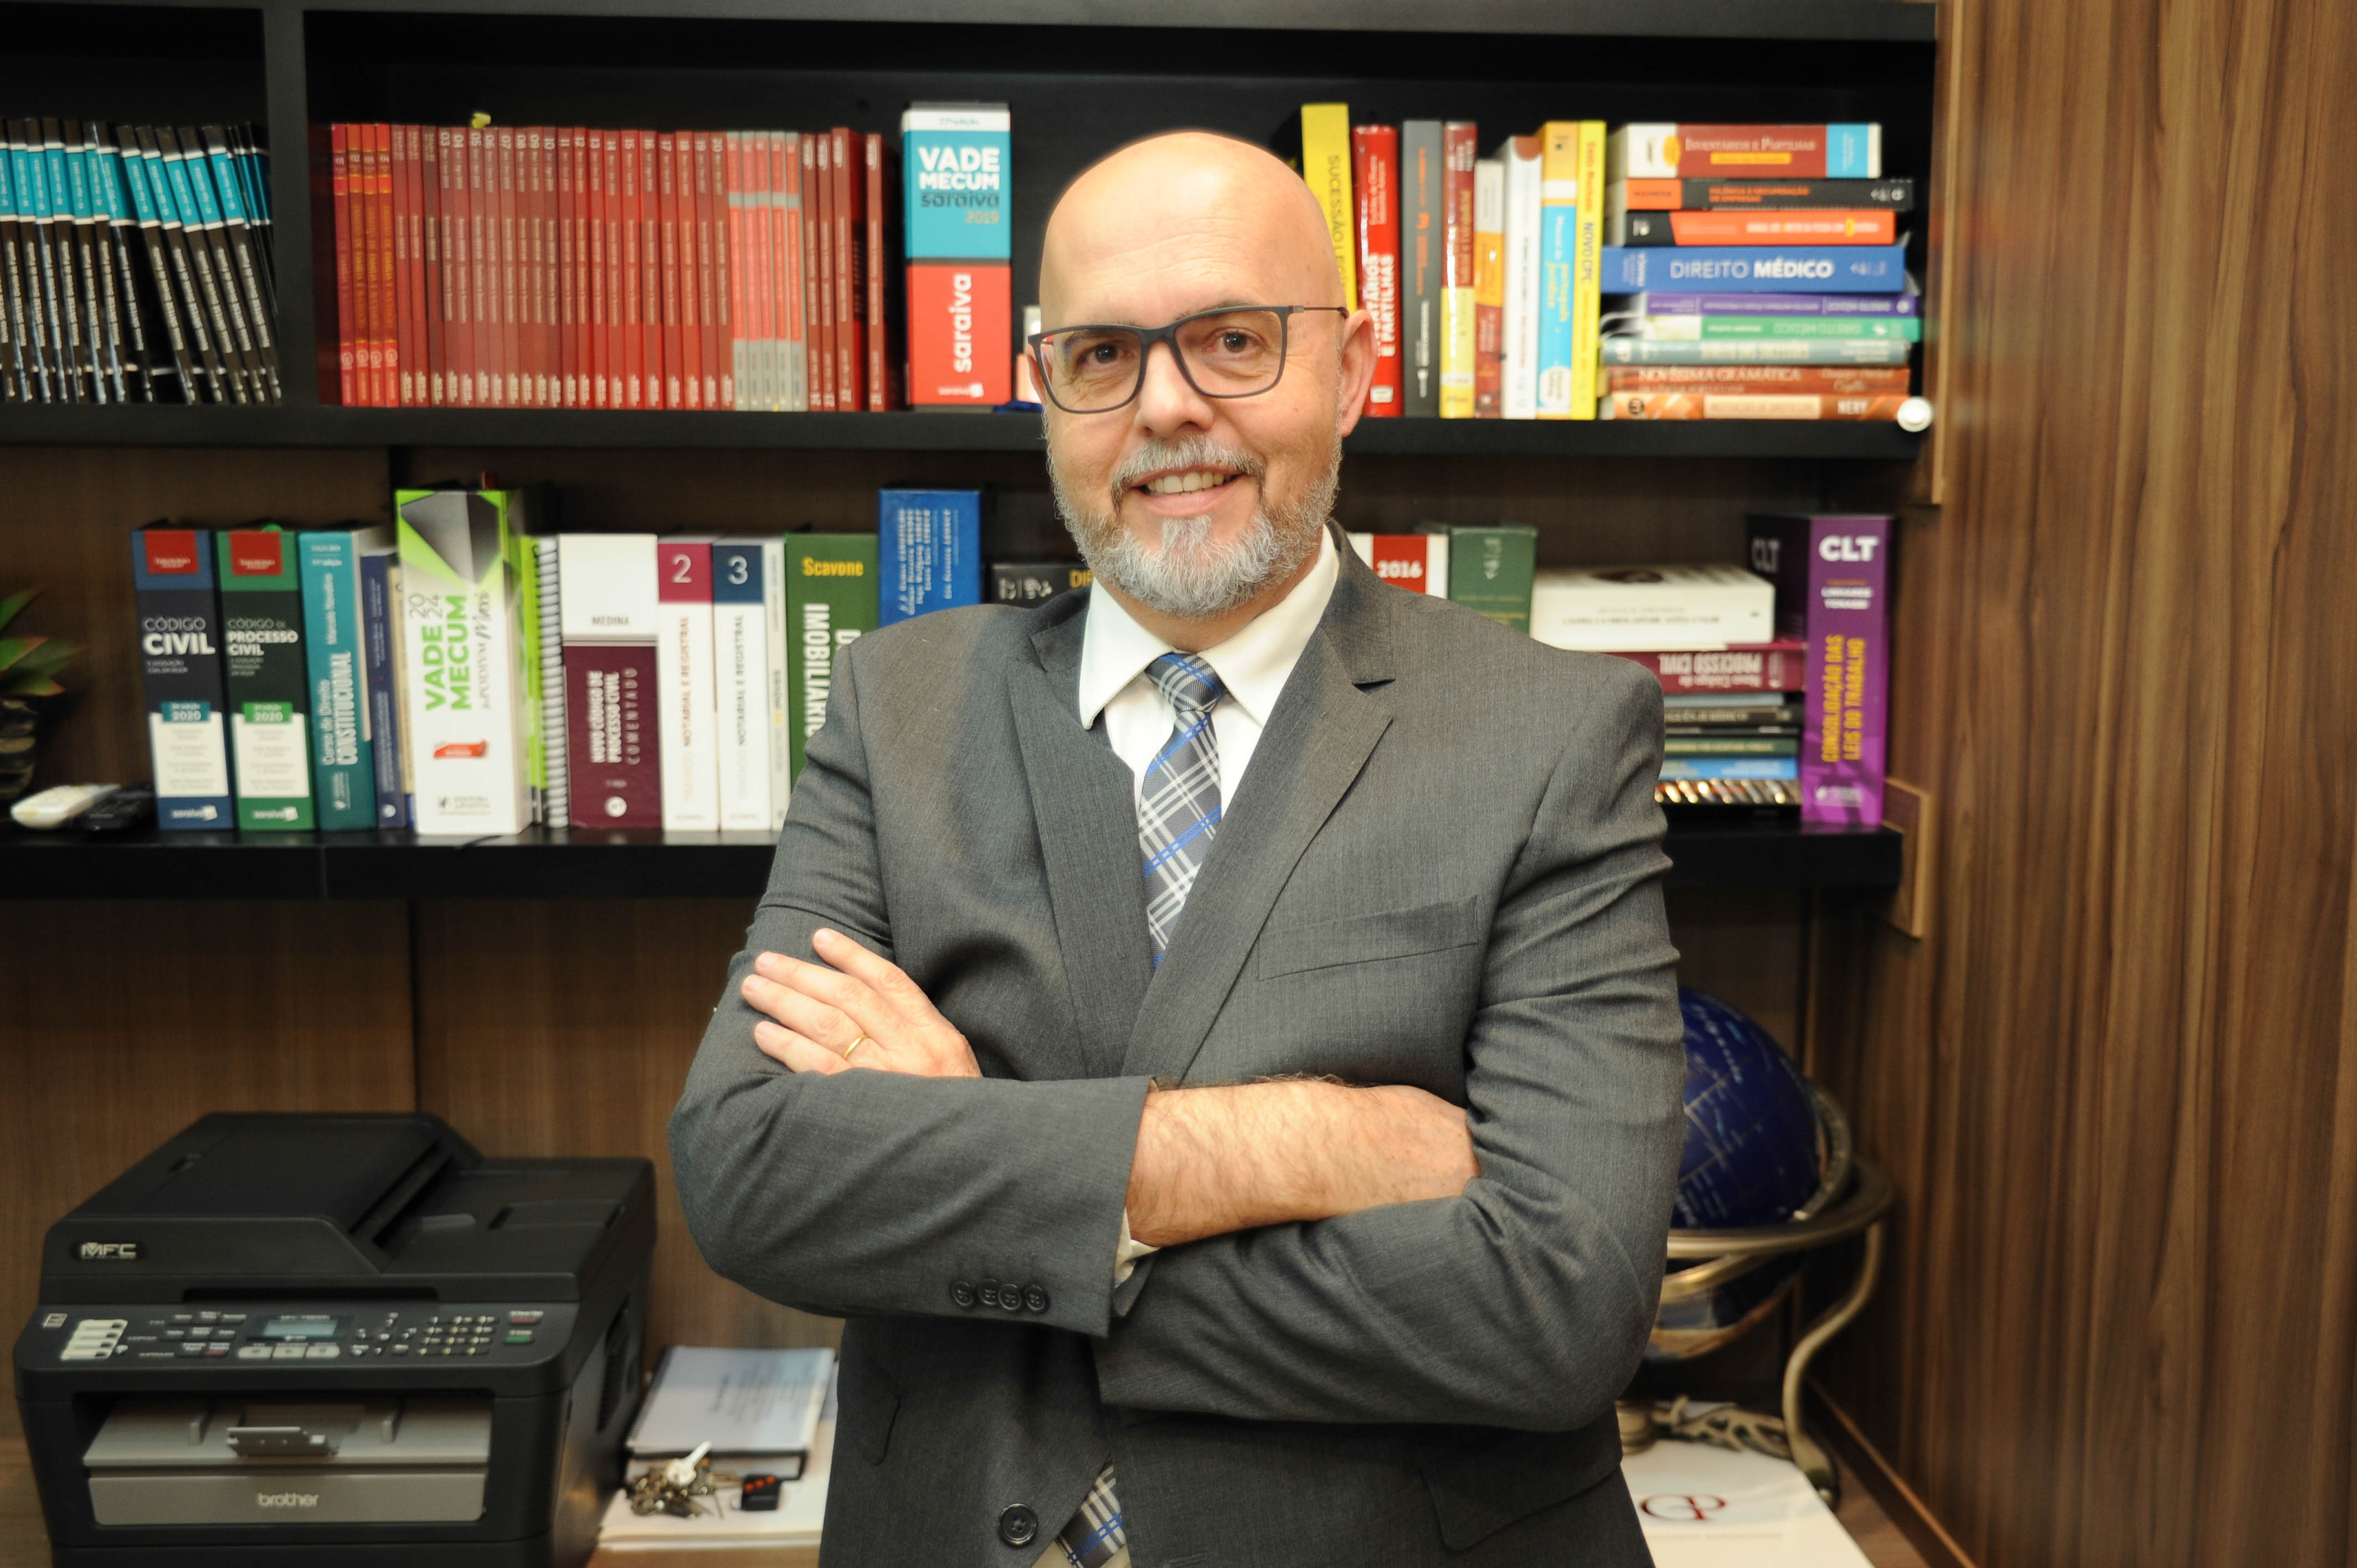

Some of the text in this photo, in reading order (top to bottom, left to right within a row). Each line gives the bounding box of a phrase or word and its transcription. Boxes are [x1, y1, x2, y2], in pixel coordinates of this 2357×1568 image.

[918, 147, 1000, 172] VADE
[919, 173, 1000, 190] MECUM
[921, 192, 999, 208] saraiva
[966, 210, 999, 224] 2019
[1583, 223, 1593, 257] NOVO
[1670, 260, 1749, 278] DIREITO
[1753, 256, 1834, 279] MÉDICO
[1380, 254, 1396, 357] E PARTILHAS
[949, 274, 972, 373] saraiva
[1819, 535, 1878, 561] CLT
[672, 554, 693, 584] 2
[727, 555, 748, 585] 3
[803, 557, 864, 576] Scavone
[1377, 560, 1423, 579] 2016
[144, 616, 207, 631] CÓDIGO
[225, 630, 299, 643] PROCESSO
[227, 617, 274, 630] CÓDIGO
[142, 632, 216, 656] CIVIL
[227, 643, 265, 656] CIVIL
[445, 595, 472, 710] MECUM
[679, 616, 690, 677] REGISTRAL
[734, 615, 744, 675] REGISTRAL
[421, 625, 446, 711] VADE
[1844, 638, 1865, 706] TRABALHO
[171, 711, 202, 721] 2020
[254, 712, 284, 722] 2020
[331, 651, 358, 766] CONSTITUCIONAL
[587, 687, 605, 730] CÓDIGO
[604, 672, 622, 763] PROCESSO CIVIL
[624, 667, 641, 765] COMENTADO
[681, 691, 692, 747] NOTARIAL
[737, 689, 746, 746] NOTARIAL
[1821, 664, 1844, 762] CONSOLIDAÇÃO
[589, 730, 606, 763] NOVO
[1843, 730, 1862, 760] LEIS
[82, 1242, 137, 1258] MFC
[258, 1492, 319, 1507] brother
